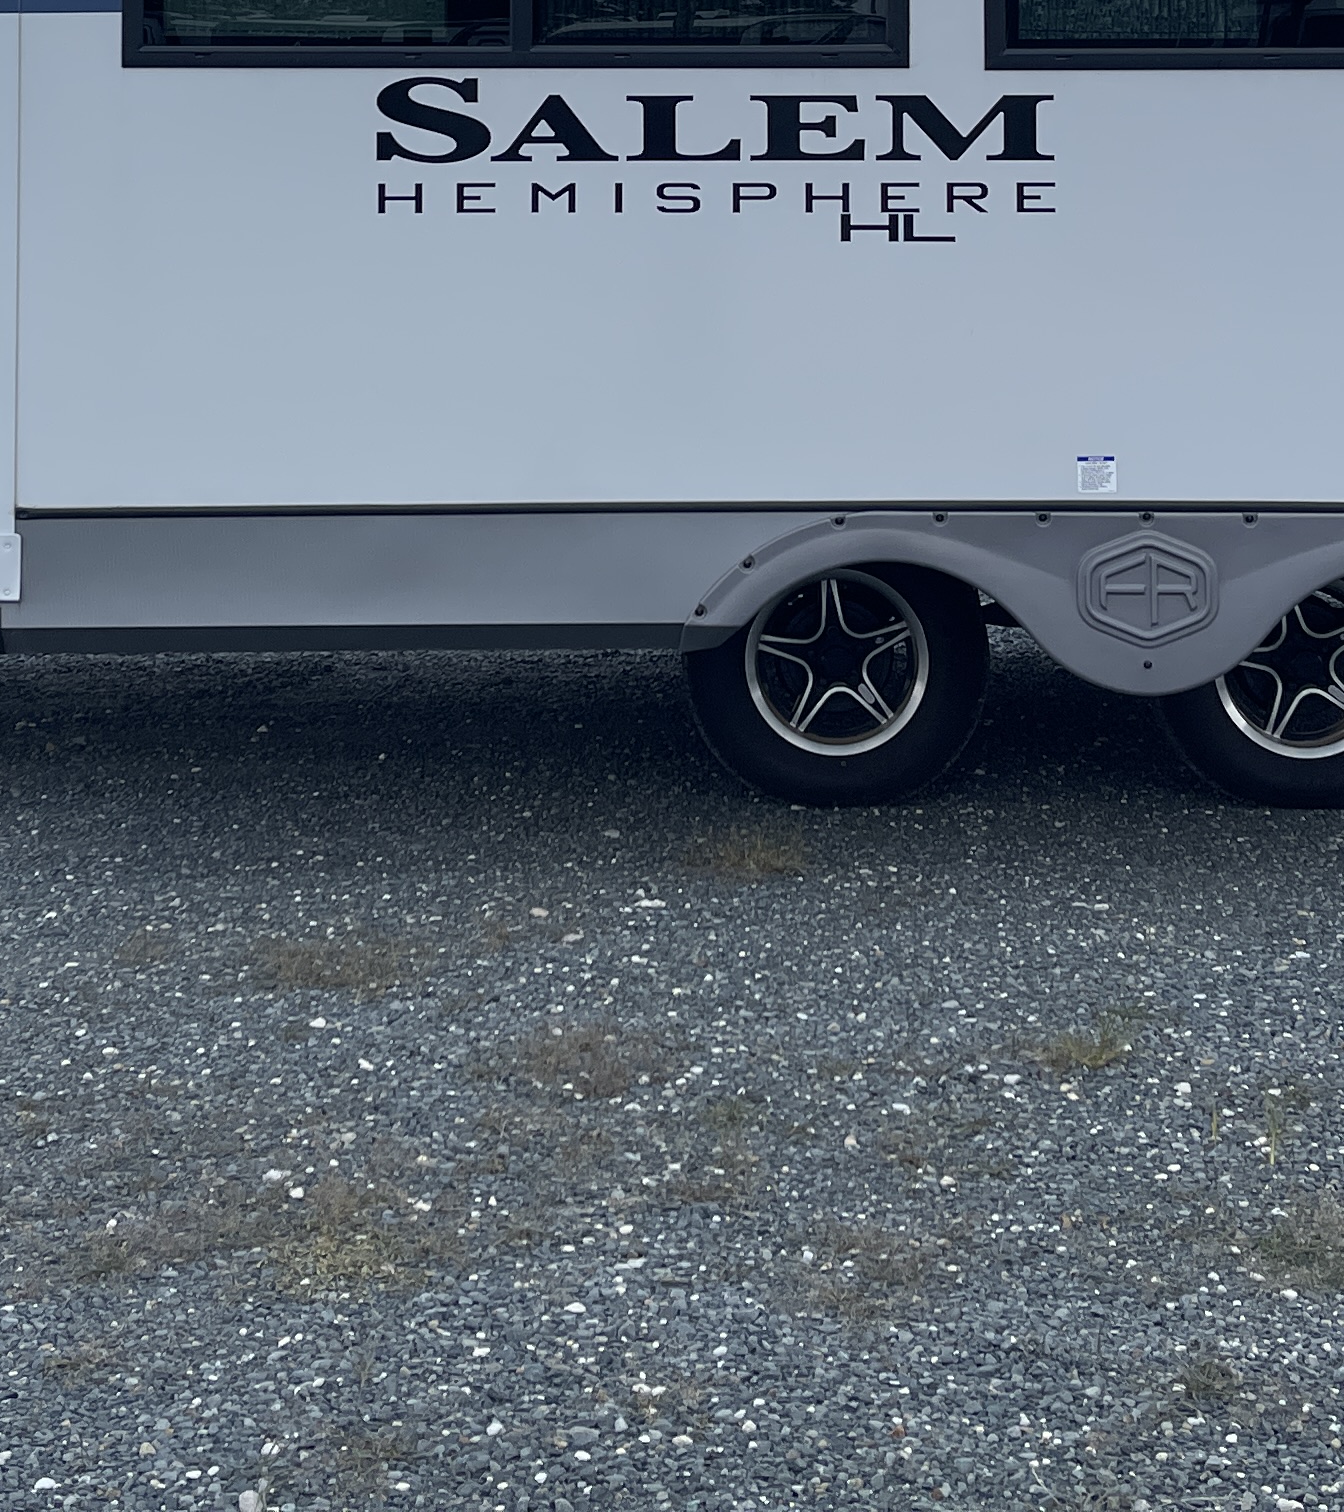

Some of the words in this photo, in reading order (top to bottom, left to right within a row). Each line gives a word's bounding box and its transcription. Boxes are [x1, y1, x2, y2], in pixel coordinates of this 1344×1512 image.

[376, 76, 1055, 164] SALEM
[377, 182, 1056, 213] HEMISPHERE
[840, 213, 956, 243] HL
[1099, 552, 1199, 628] FR
